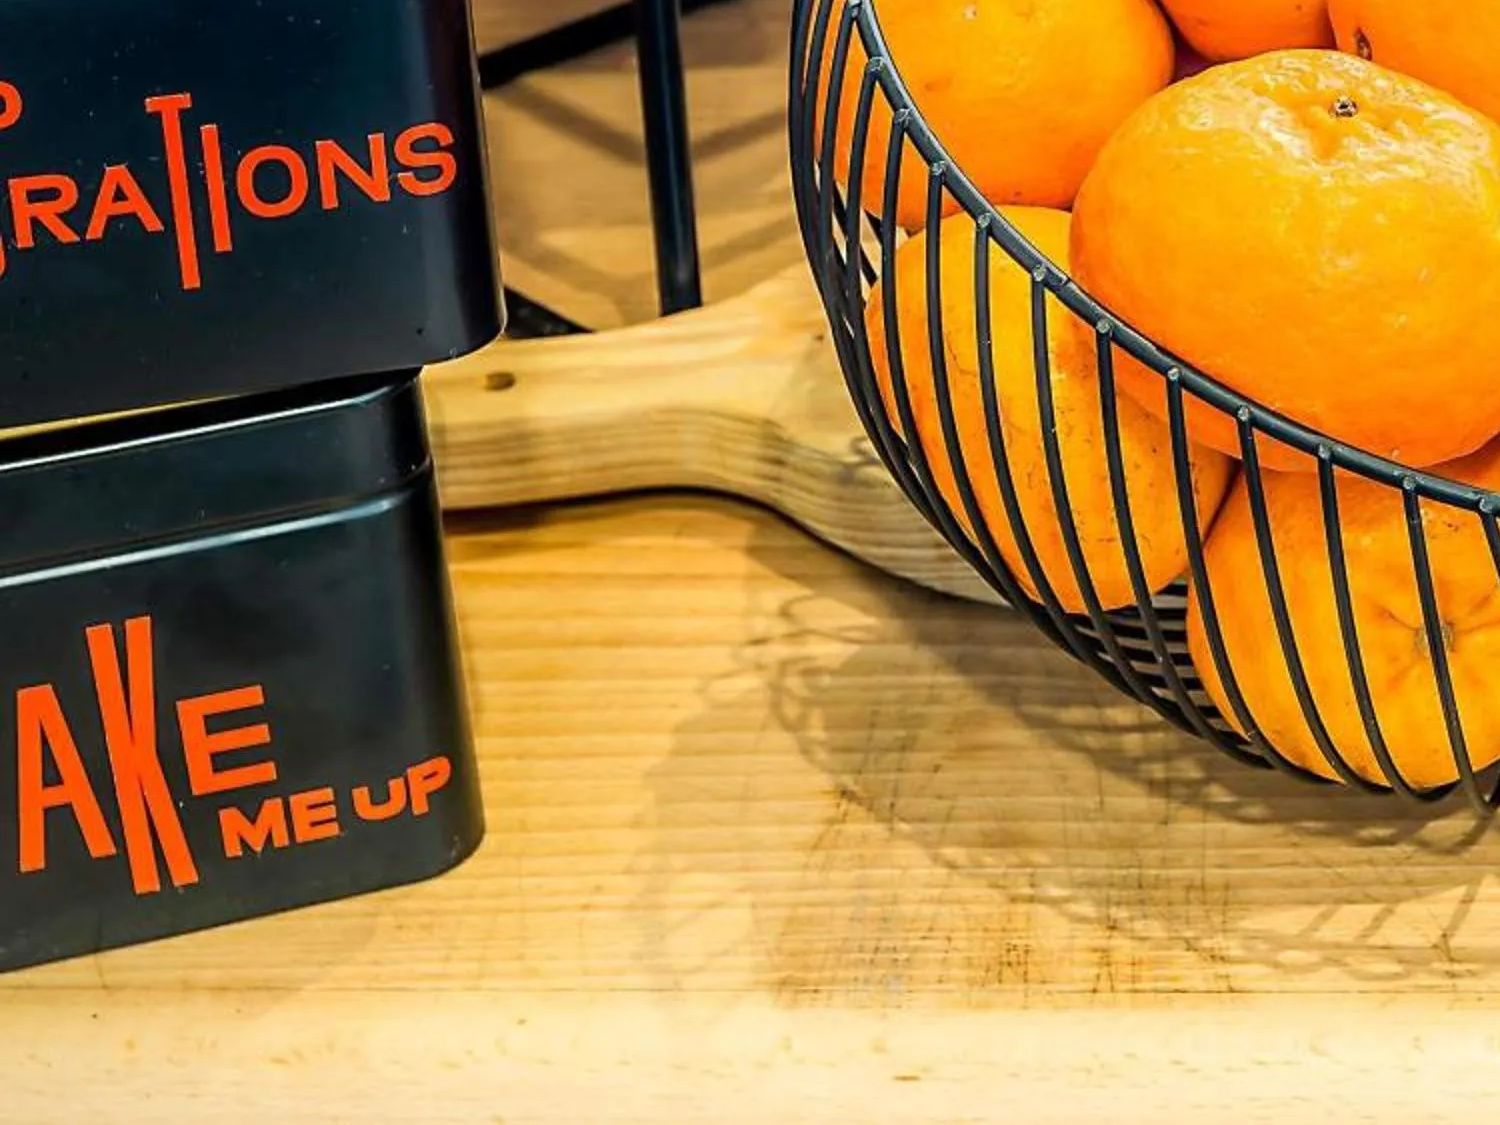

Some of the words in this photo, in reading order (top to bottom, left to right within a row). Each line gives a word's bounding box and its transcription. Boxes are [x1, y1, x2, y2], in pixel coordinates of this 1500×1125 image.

[0, 92, 458, 290] RATIONS
[218, 787, 341, 859] ME
[351, 756, 452, 821] UP
